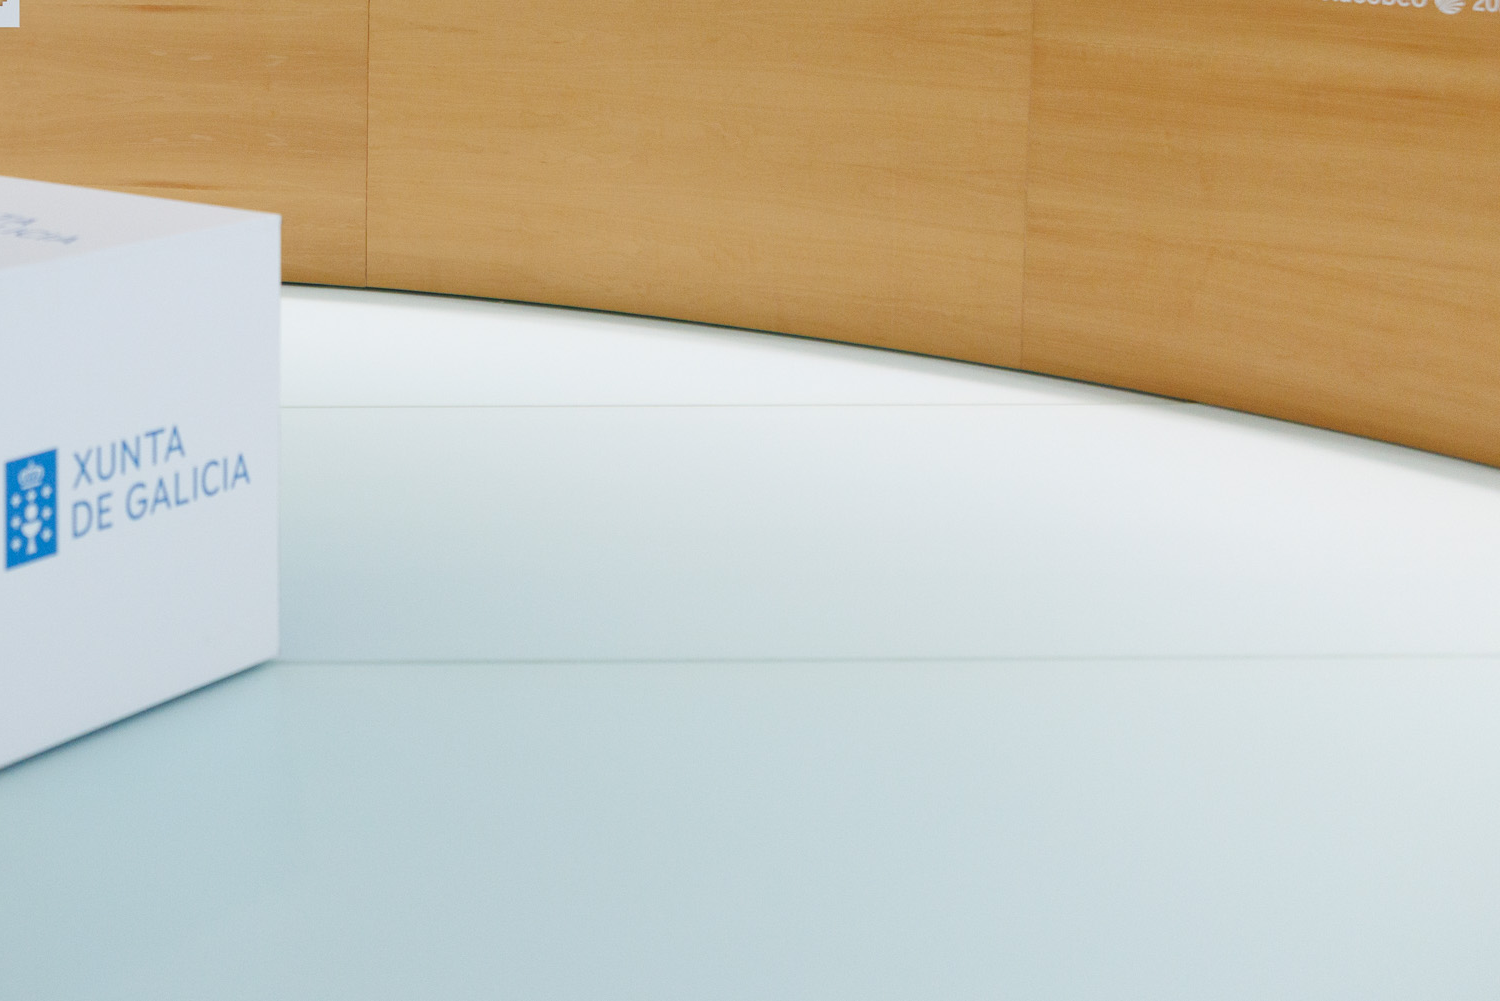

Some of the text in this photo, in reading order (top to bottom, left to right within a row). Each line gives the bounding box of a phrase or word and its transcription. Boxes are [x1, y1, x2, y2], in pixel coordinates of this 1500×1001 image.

[72, 425, 186, 490] XUNTA
[71, 453, 250, 540] DE GALICIA
